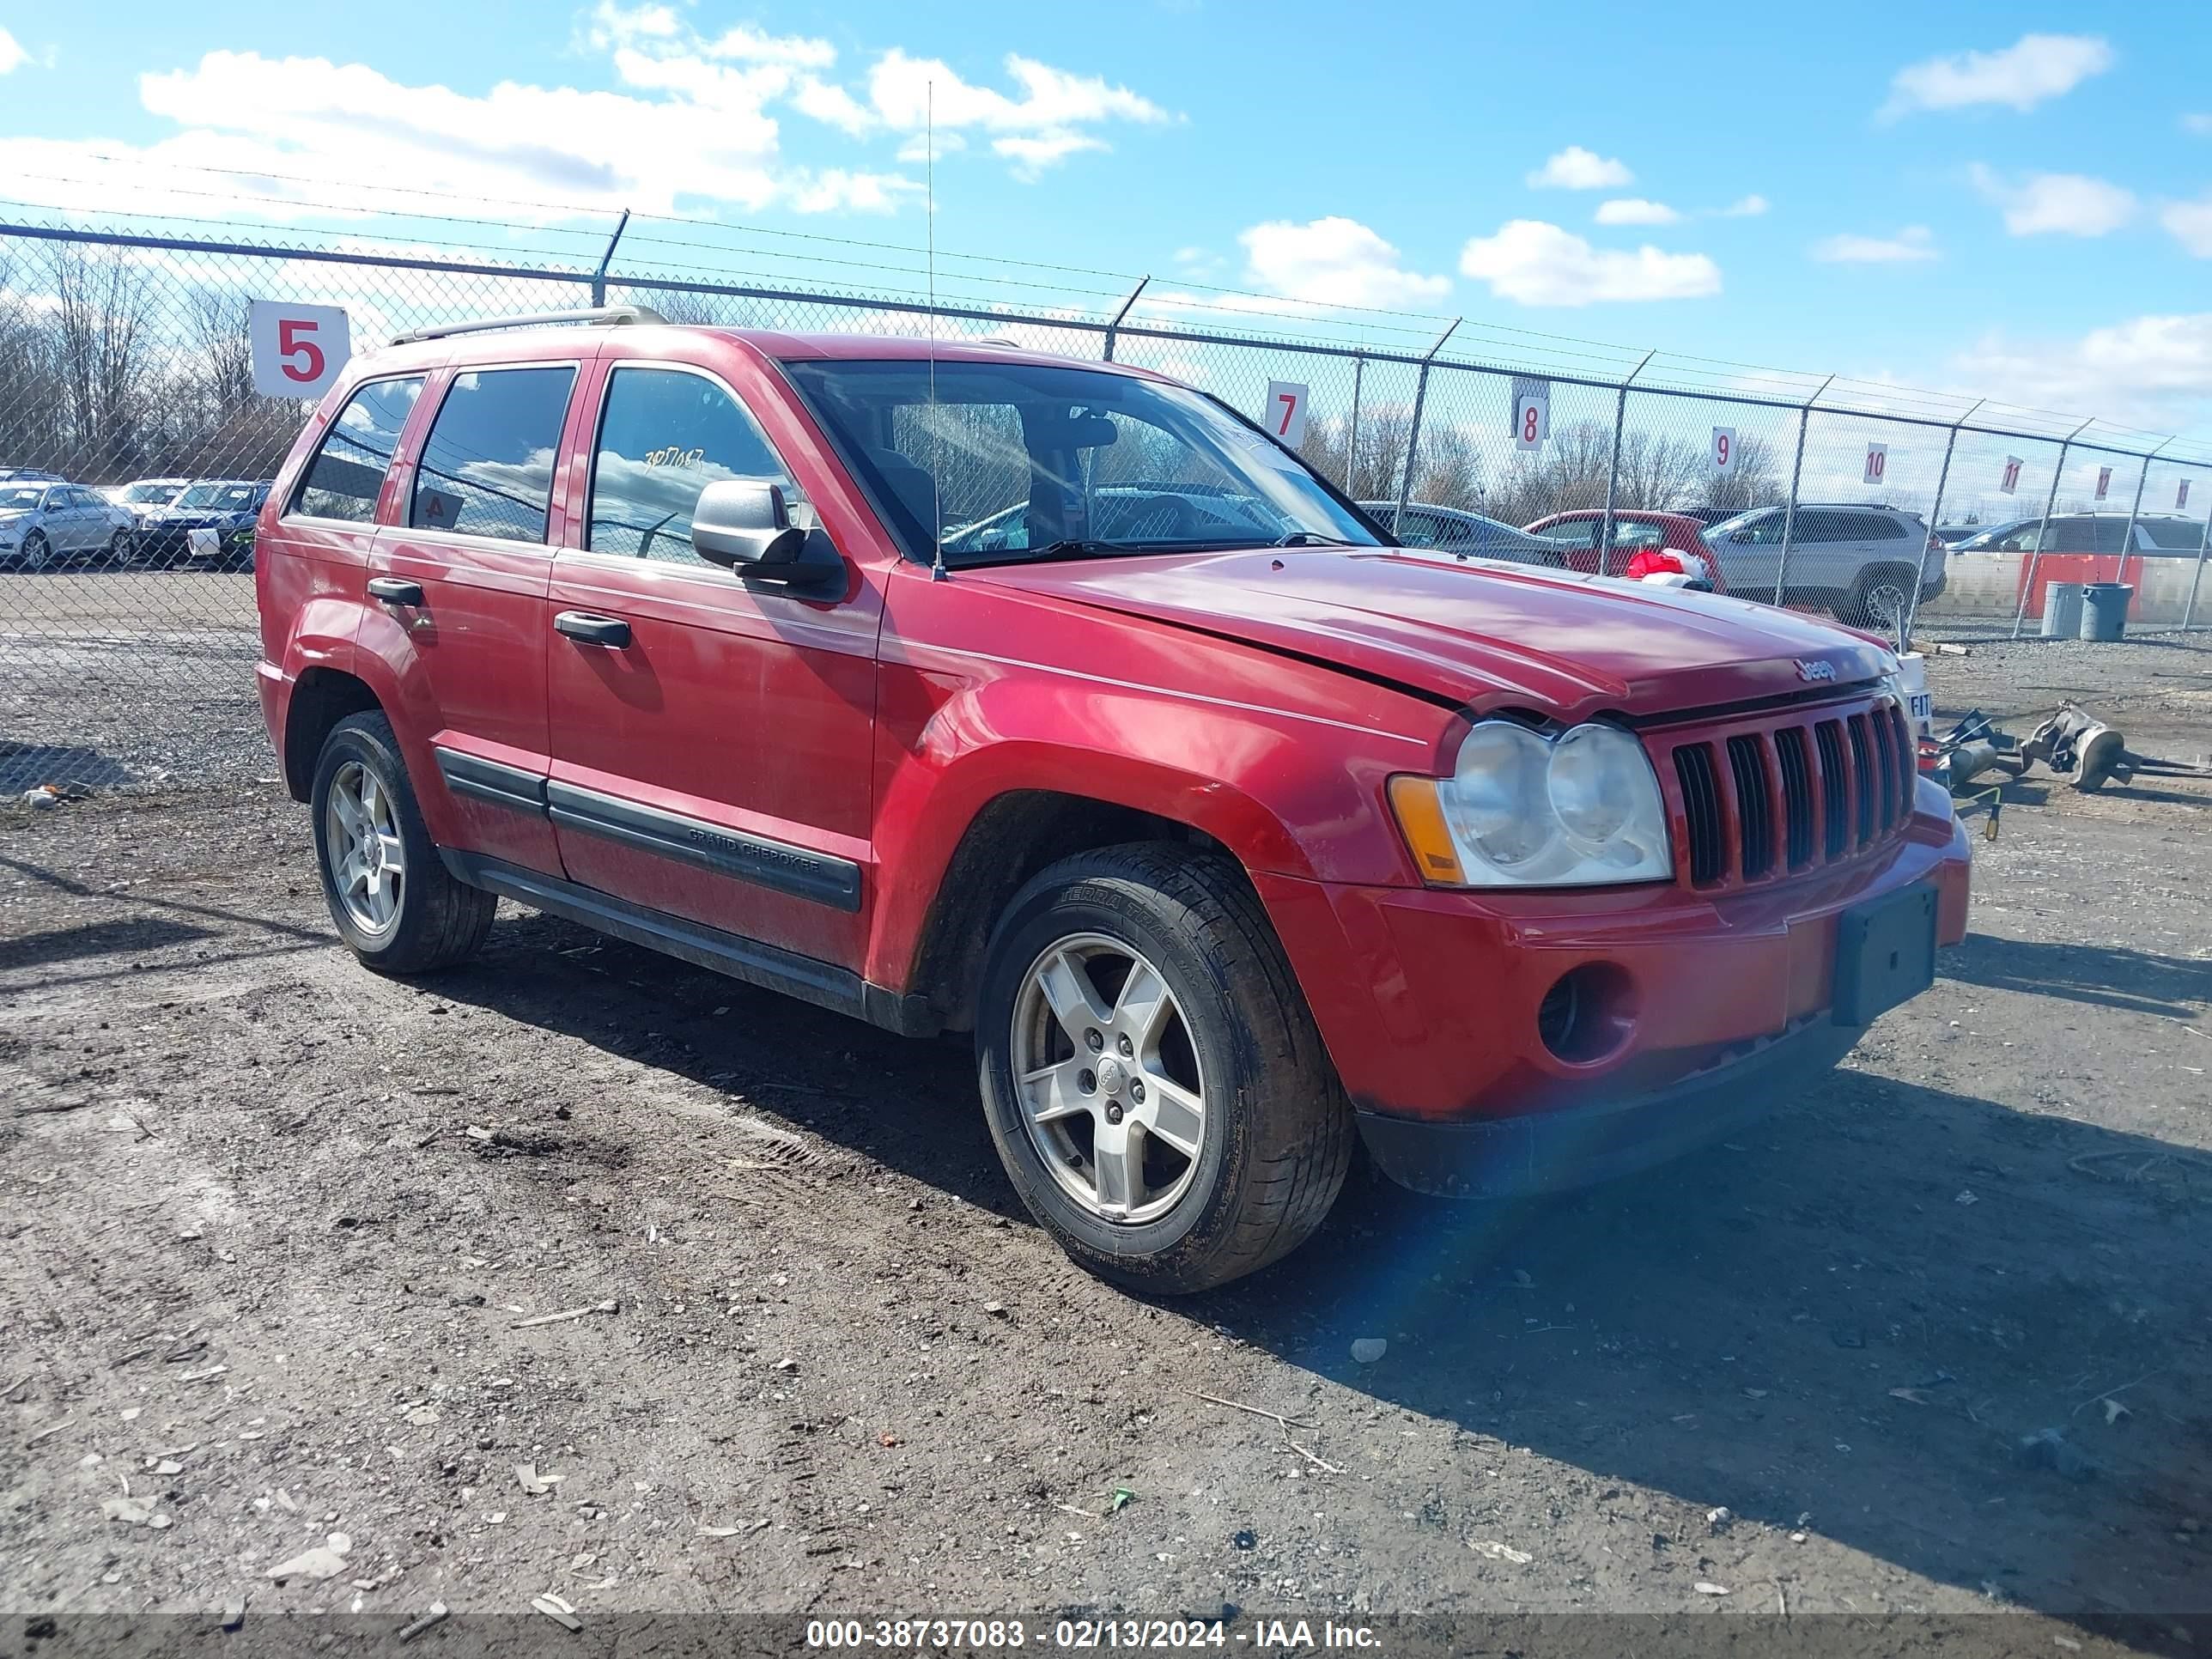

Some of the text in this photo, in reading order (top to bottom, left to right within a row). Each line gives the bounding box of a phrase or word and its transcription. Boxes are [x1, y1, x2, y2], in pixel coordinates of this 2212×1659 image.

[279, 320, 325, 382] 5
[1279, 394, 1296, 435] 7
[1524, 407, 1538, 442] 8
[1717, 434, 1729, 465] 9
[1869, 452, 1884, 477] 10
[2005, 463, 2020, 489] 11
[2098, 473, 2110, 495] 12
[1794, 659, 1836, 682] Jeep
[689, 829, 820, 873] GRAND CHEROKEE
[1059, 885, 1122, 909] TERRA
